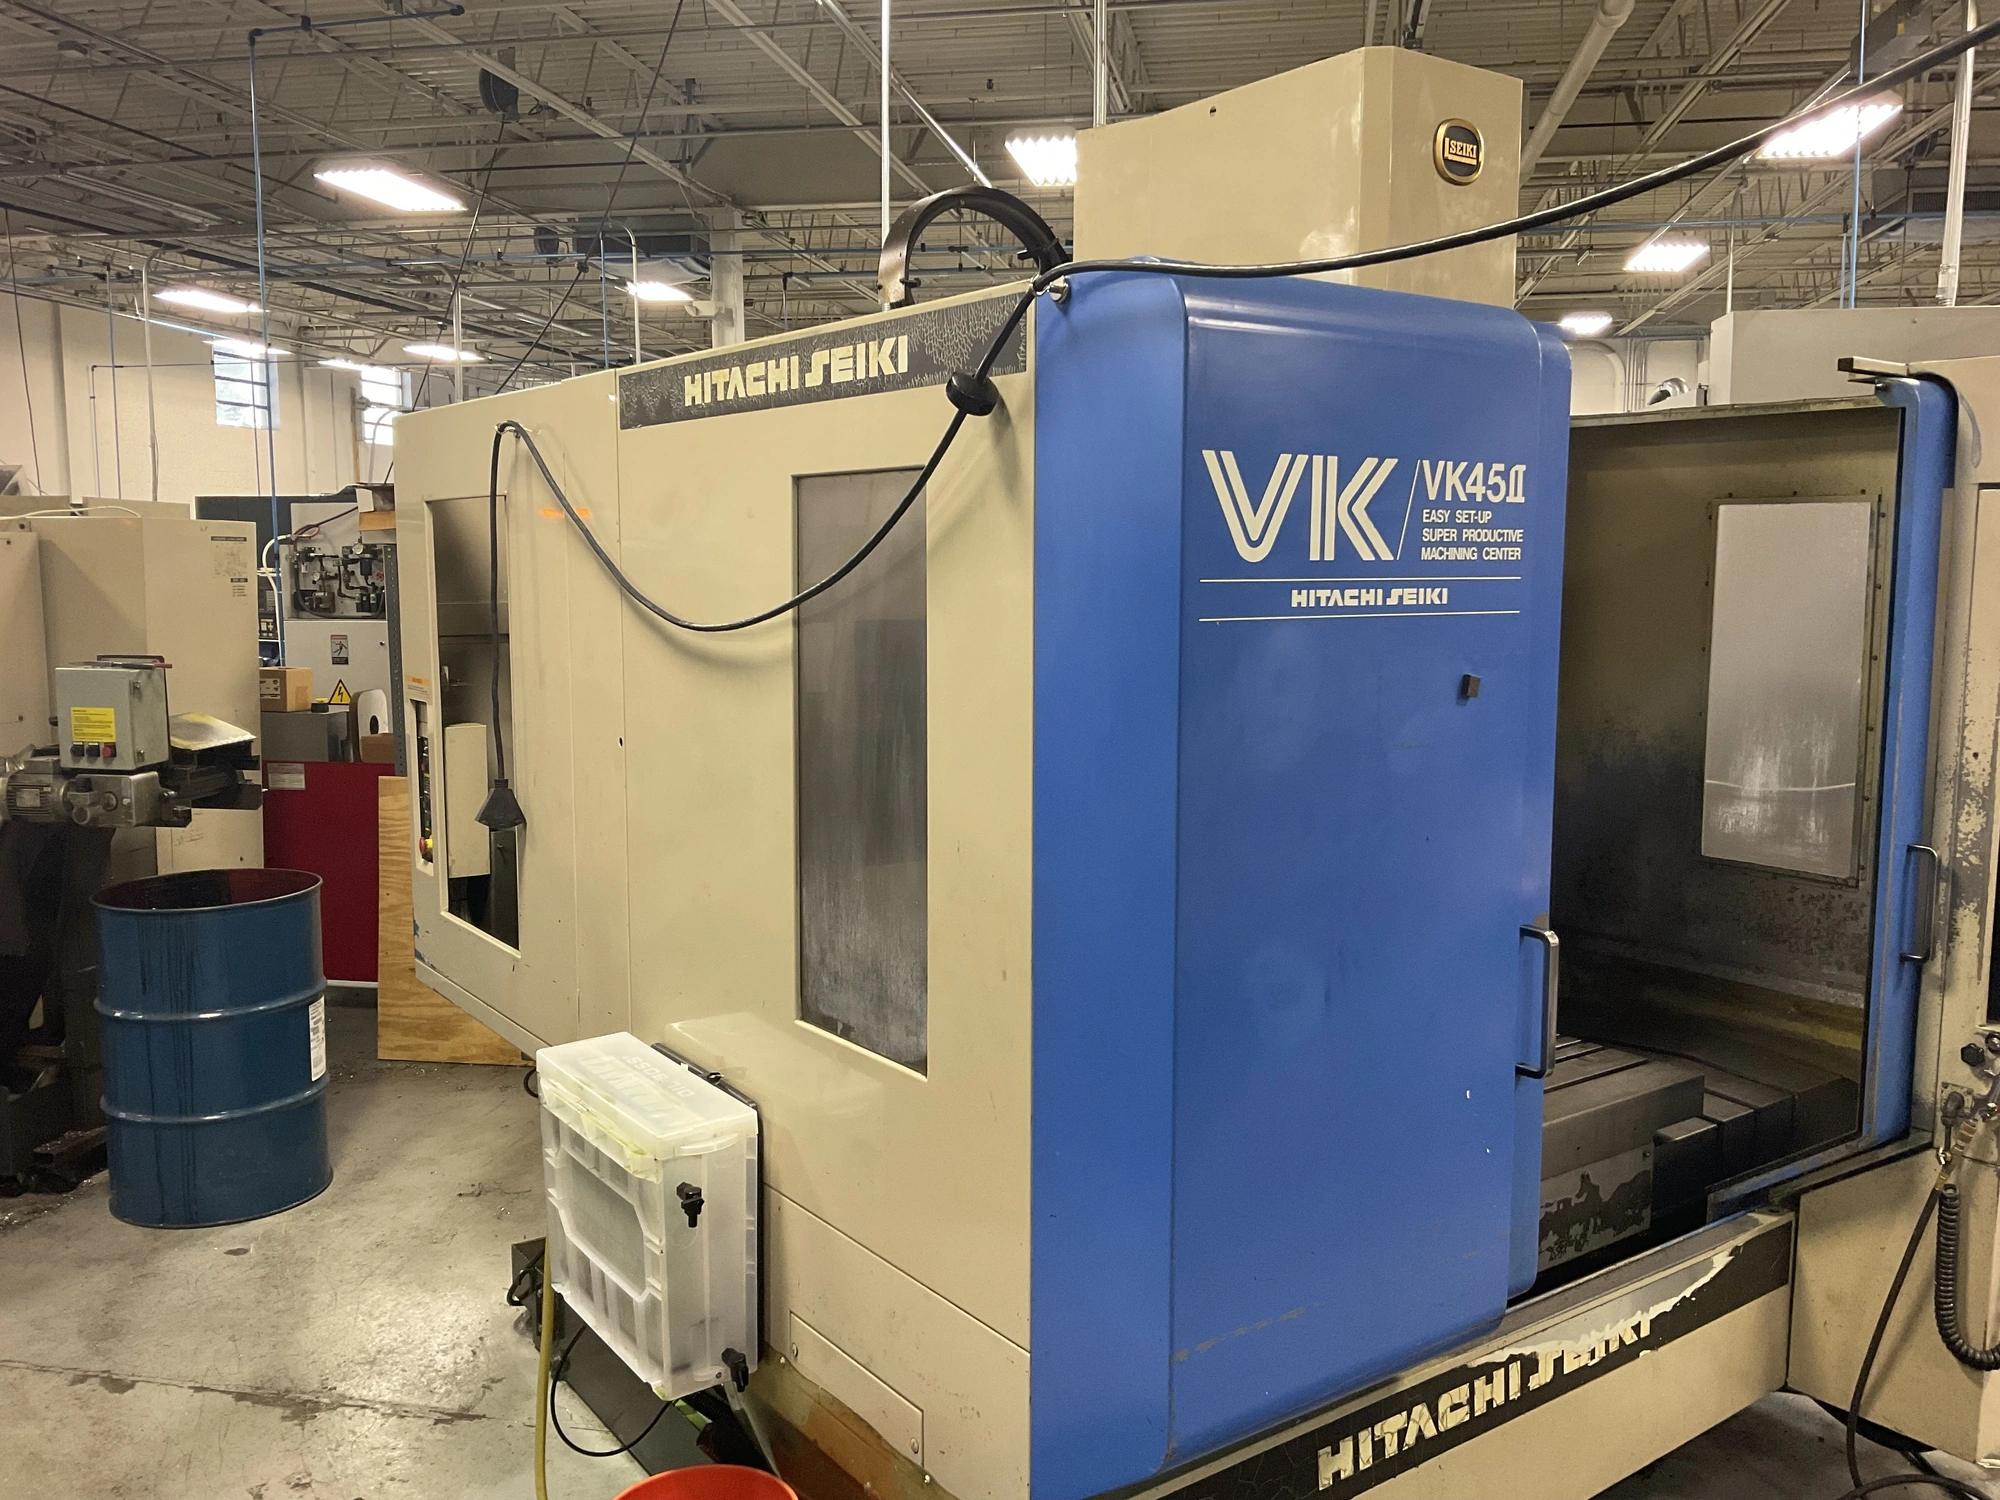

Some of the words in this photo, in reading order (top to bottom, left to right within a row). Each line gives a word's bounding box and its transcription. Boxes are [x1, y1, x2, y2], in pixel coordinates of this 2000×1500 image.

[1449, 139, 1477, 158] SEIKI
[684, 356, 800, 407] HITACHI
[804, 335, 909, 388] SEIKI
[1202, 449, 1399, 562] VK
[1422, 509, 1450, 523] EASY
[1455, 510, 1493, 524] SET-UP
[1422, 528, 1457, 542] SUPER
[1462, 528, 1524, 542] PRODUCTIVE
[1421, 547, 1478, 560] MACHINING
[1482, 547, 1522, 560] CENTER
[1291, 588, 1383, 607] HITACHI
[1386, 587, 1448, 605] SEIKI
[667, 1080, 695, 1098] OIL
[1317, 1360, 1521, 1491] HITACHI
